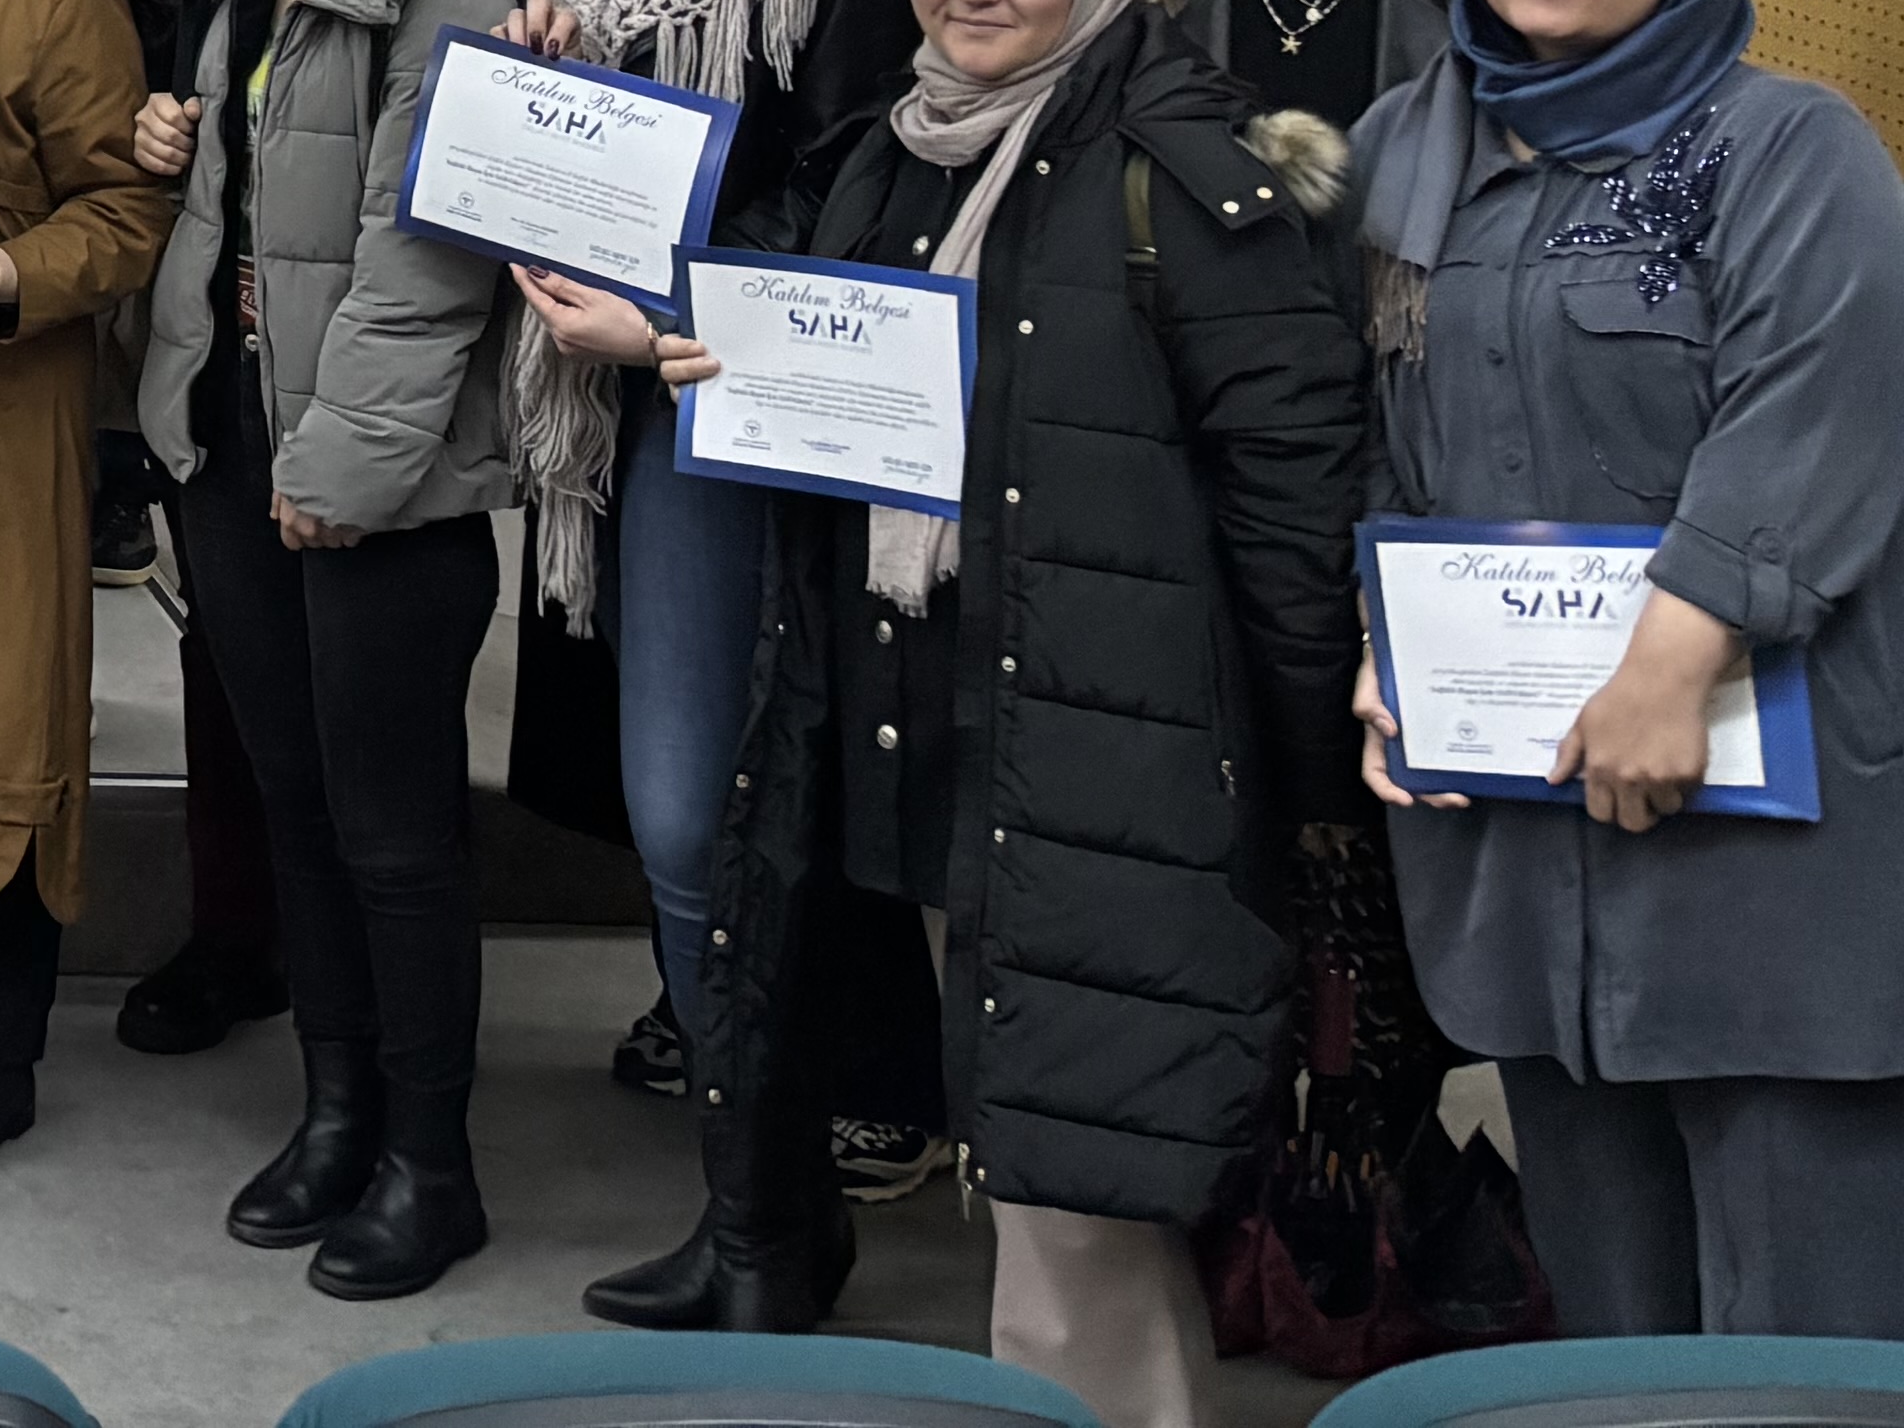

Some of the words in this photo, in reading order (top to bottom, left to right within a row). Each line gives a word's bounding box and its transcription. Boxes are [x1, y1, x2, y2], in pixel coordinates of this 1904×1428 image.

[526, 100, 607, 145] SAHA
[788, 308, 872, 346] SAHA
[1568, 553, 1647, 596] Belg
[1501, 587, 1619, 620] SAHA
